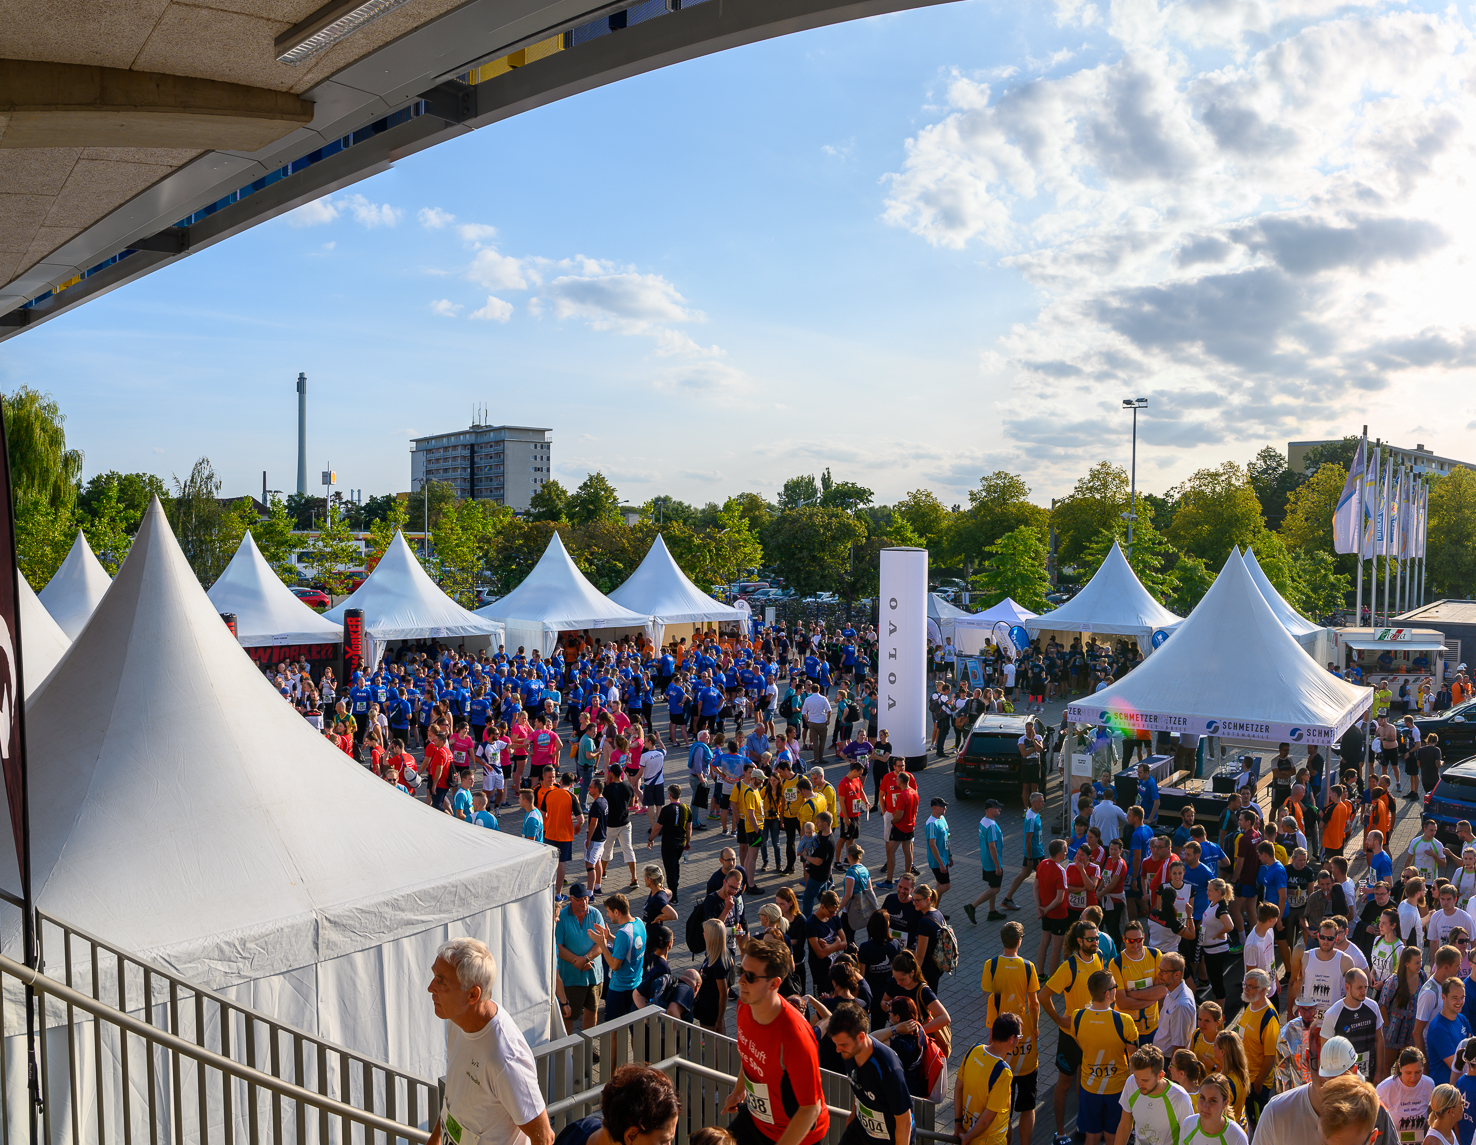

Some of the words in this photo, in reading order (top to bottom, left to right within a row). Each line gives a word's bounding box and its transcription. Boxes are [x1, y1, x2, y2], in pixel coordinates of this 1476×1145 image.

[888, 597, 898, 711] VOLVO
[1113, 711, 1158, 723] SCHMETZER
[1222, 721, 1270, 733] SCHMETZER
[1069, 895, 1085, 905] 2210
[1350, 1020, 1372, 1030] SCHMETZER
[749, 1040, 766, 1064] läuft
[1088, 1067, 1118, 1078] 2019
